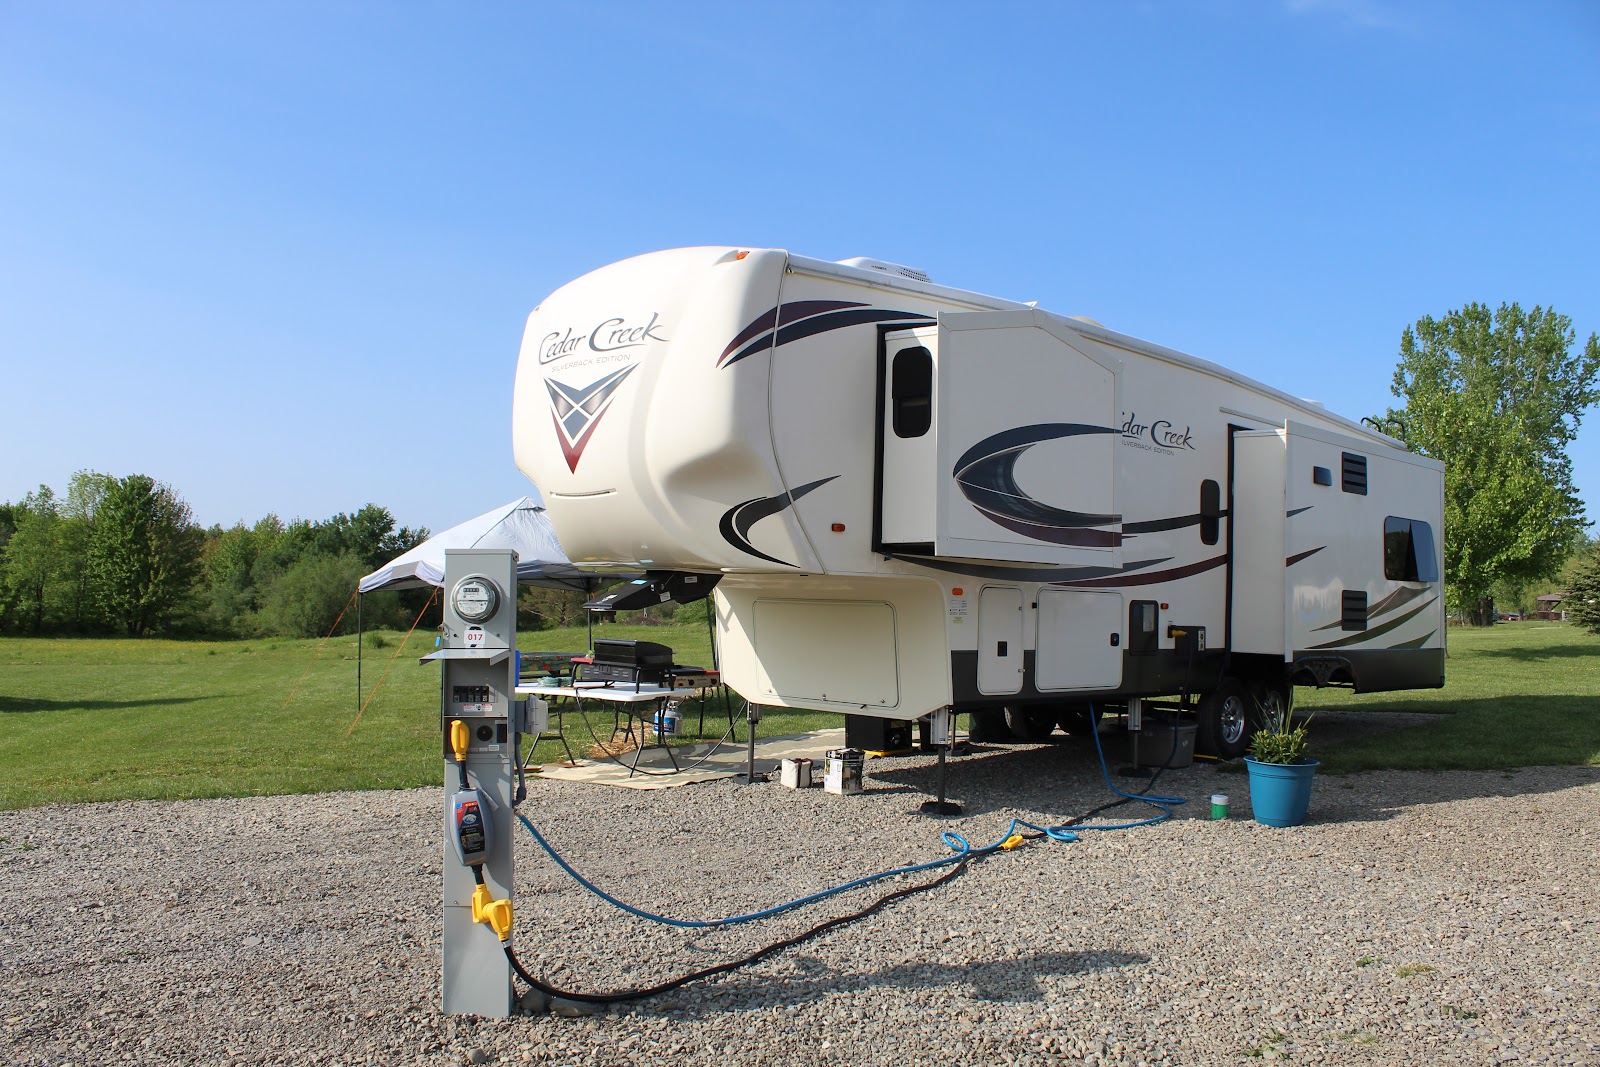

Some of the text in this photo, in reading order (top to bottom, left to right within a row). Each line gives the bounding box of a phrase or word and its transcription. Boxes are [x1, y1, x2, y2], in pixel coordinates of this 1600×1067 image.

[538, 311, 671, 365] Cedar Creek
[551, 353, 631, 373] SILVERBACK EDITION
[1121, 411, 1196, 450] dar Creek
[1121, 440, 1175, 456] ILVERBACK EDITION
[467, 633, 483, 641] 017
